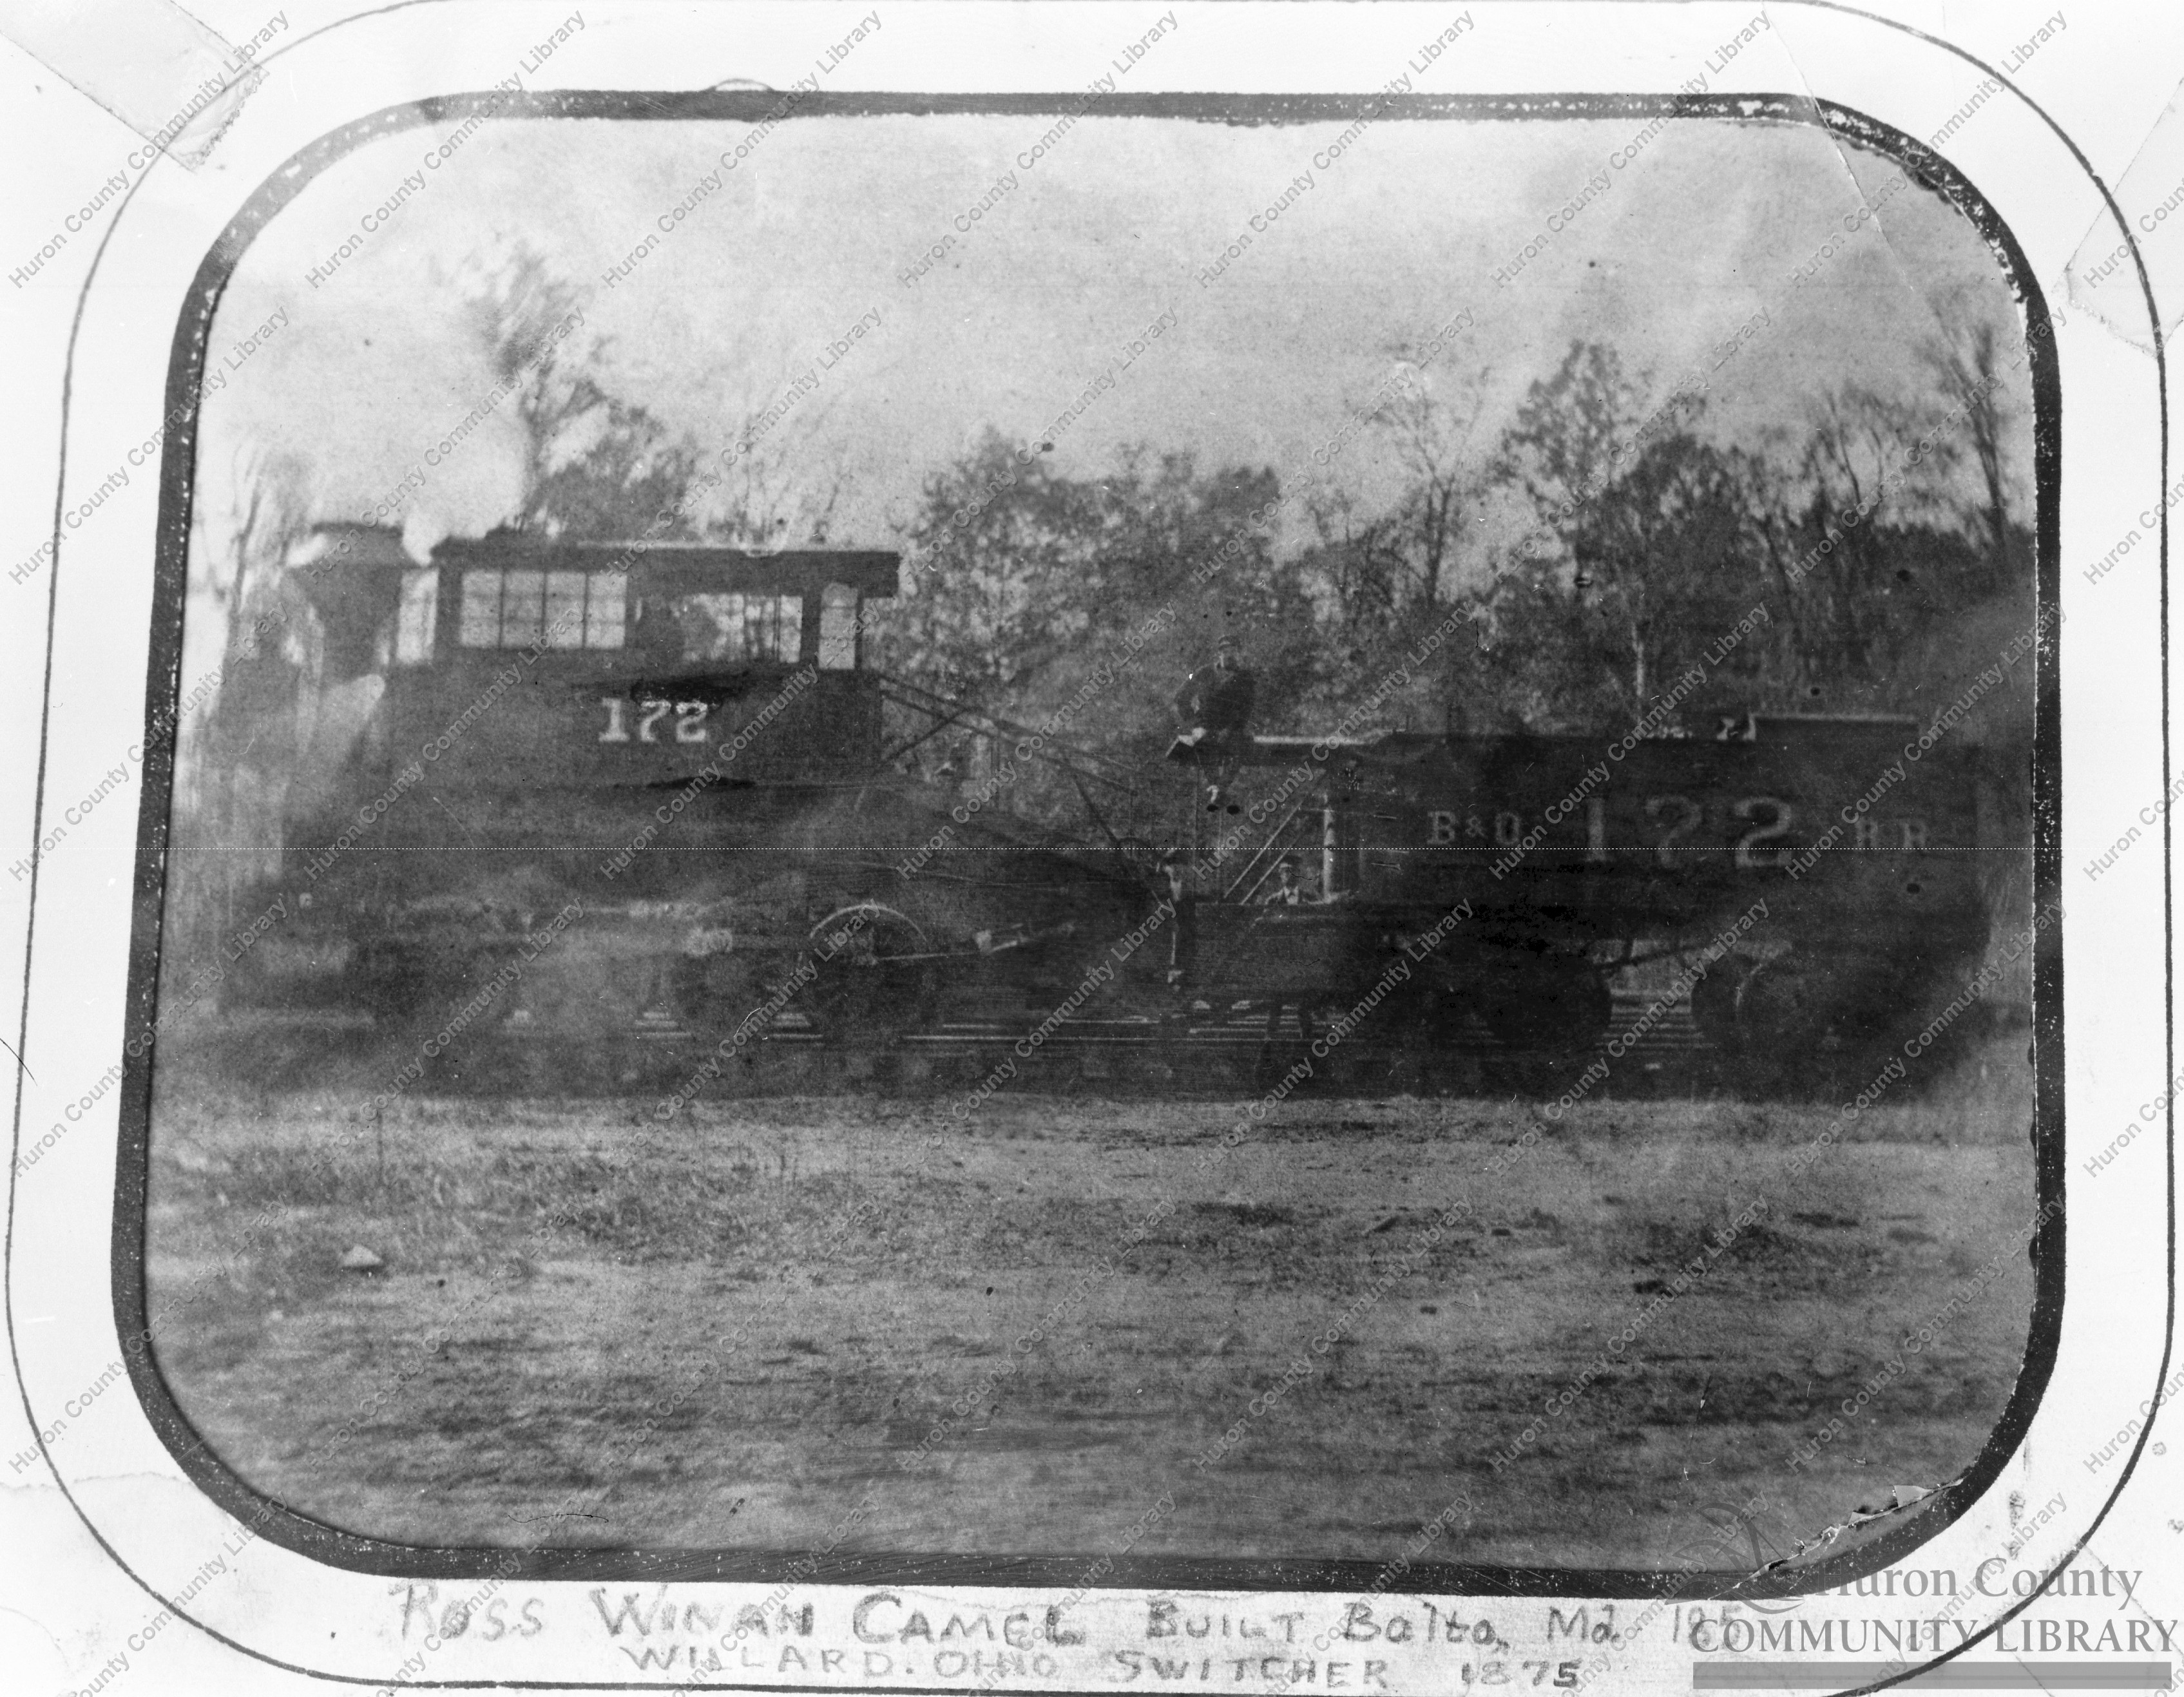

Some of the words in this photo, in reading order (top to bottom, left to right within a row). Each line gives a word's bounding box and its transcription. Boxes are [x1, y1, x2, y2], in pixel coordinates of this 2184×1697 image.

[599, 697, 708, 742] 172
[1582, 796, 1793, 869] 172
[853, 1591, 1087, 1647] CAMEL
[1145, 1598, 1305, 1644] BUILT
[1107, 1649, 1388, 1689] SWITCHER
[1461, 1657, 1583, 1687] 1875
